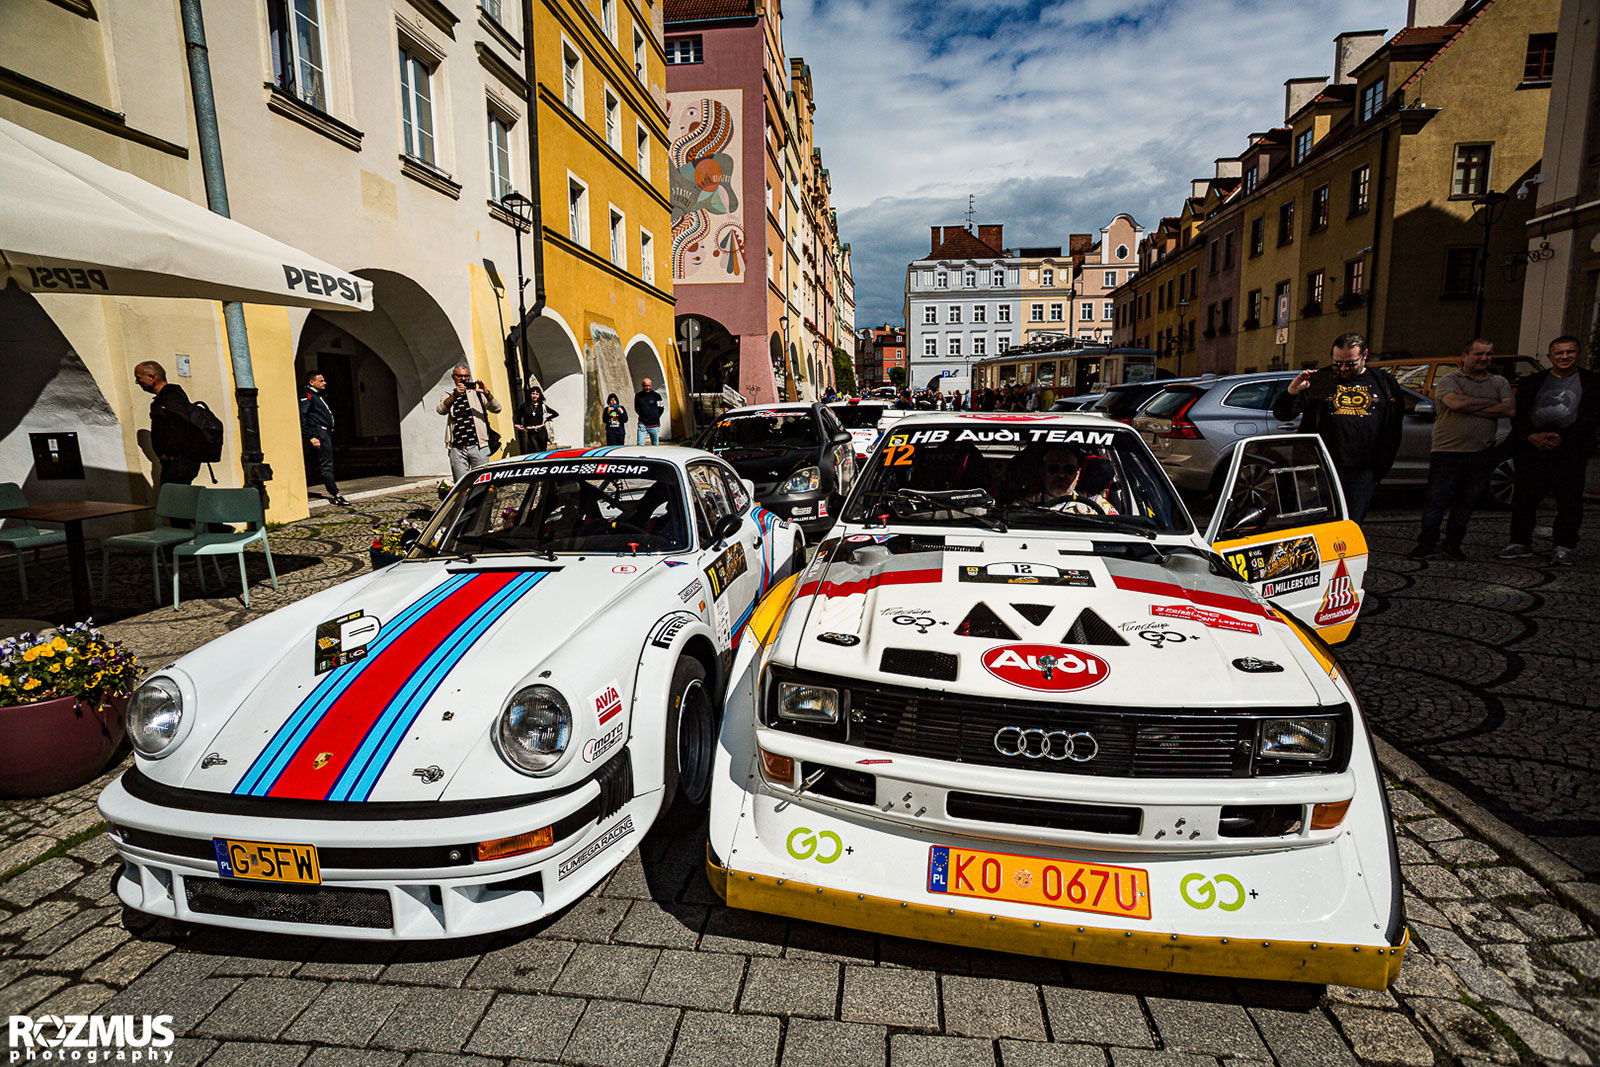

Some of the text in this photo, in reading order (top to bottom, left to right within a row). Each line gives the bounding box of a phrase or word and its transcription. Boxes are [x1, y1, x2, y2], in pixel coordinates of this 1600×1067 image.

[282, 264, 362, 303] PEPSI
[716, 420, 732, 428] 14
[910, 429, 1114, 445] HB Audi TEAM
[883, 444, 916, 467] 12
[493, 463, 649, 480] MILLERS OILS HRSMP
[1012, 563, 1033, 574] 12
[1227, 553, 1249, 582] 12
[1275, 575, 1319, 593] MILLERS OILS
[1328, 575, 1352, 610] HB
[1318, 605, 1355, 622] international
[595, 686, 620, 712] AVIA
[559, 819, 634, 877] KUMIEGA RACING
[221, 861, 232, 870] PL
[230, 844, 250, 874] G
[933, 873, 946, 885] PL
